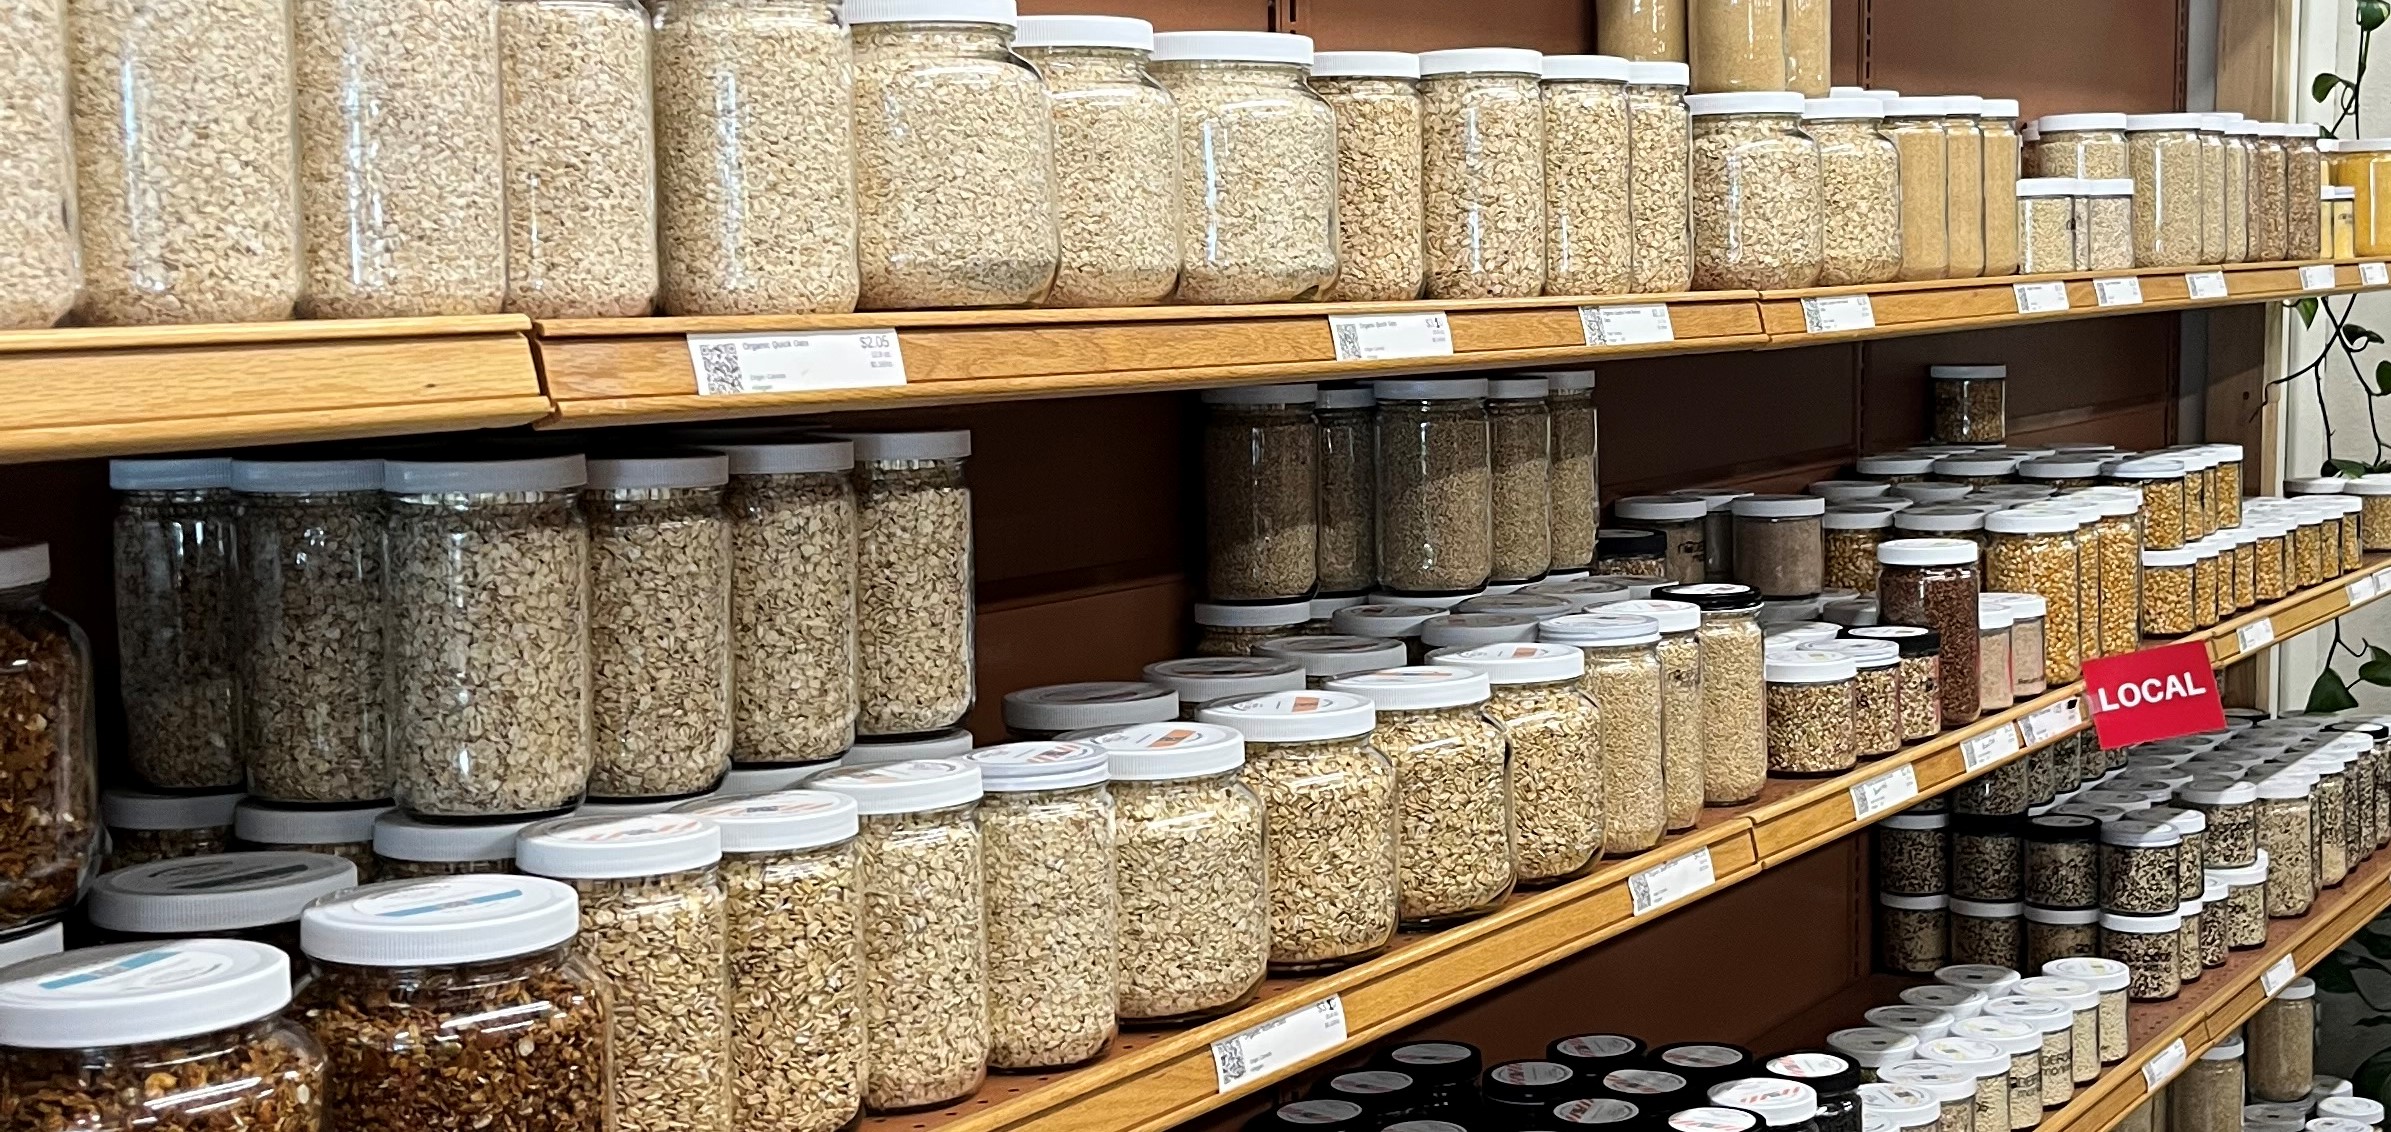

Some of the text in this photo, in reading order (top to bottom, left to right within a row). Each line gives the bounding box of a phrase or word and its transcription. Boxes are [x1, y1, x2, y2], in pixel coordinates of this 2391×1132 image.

[742, 342, 770, 351] Organic
[772, 340, 792, 349] Quick
[859, 334, 890, 349] $2.05
[2097, 671, 2207, 712] LOCAL
